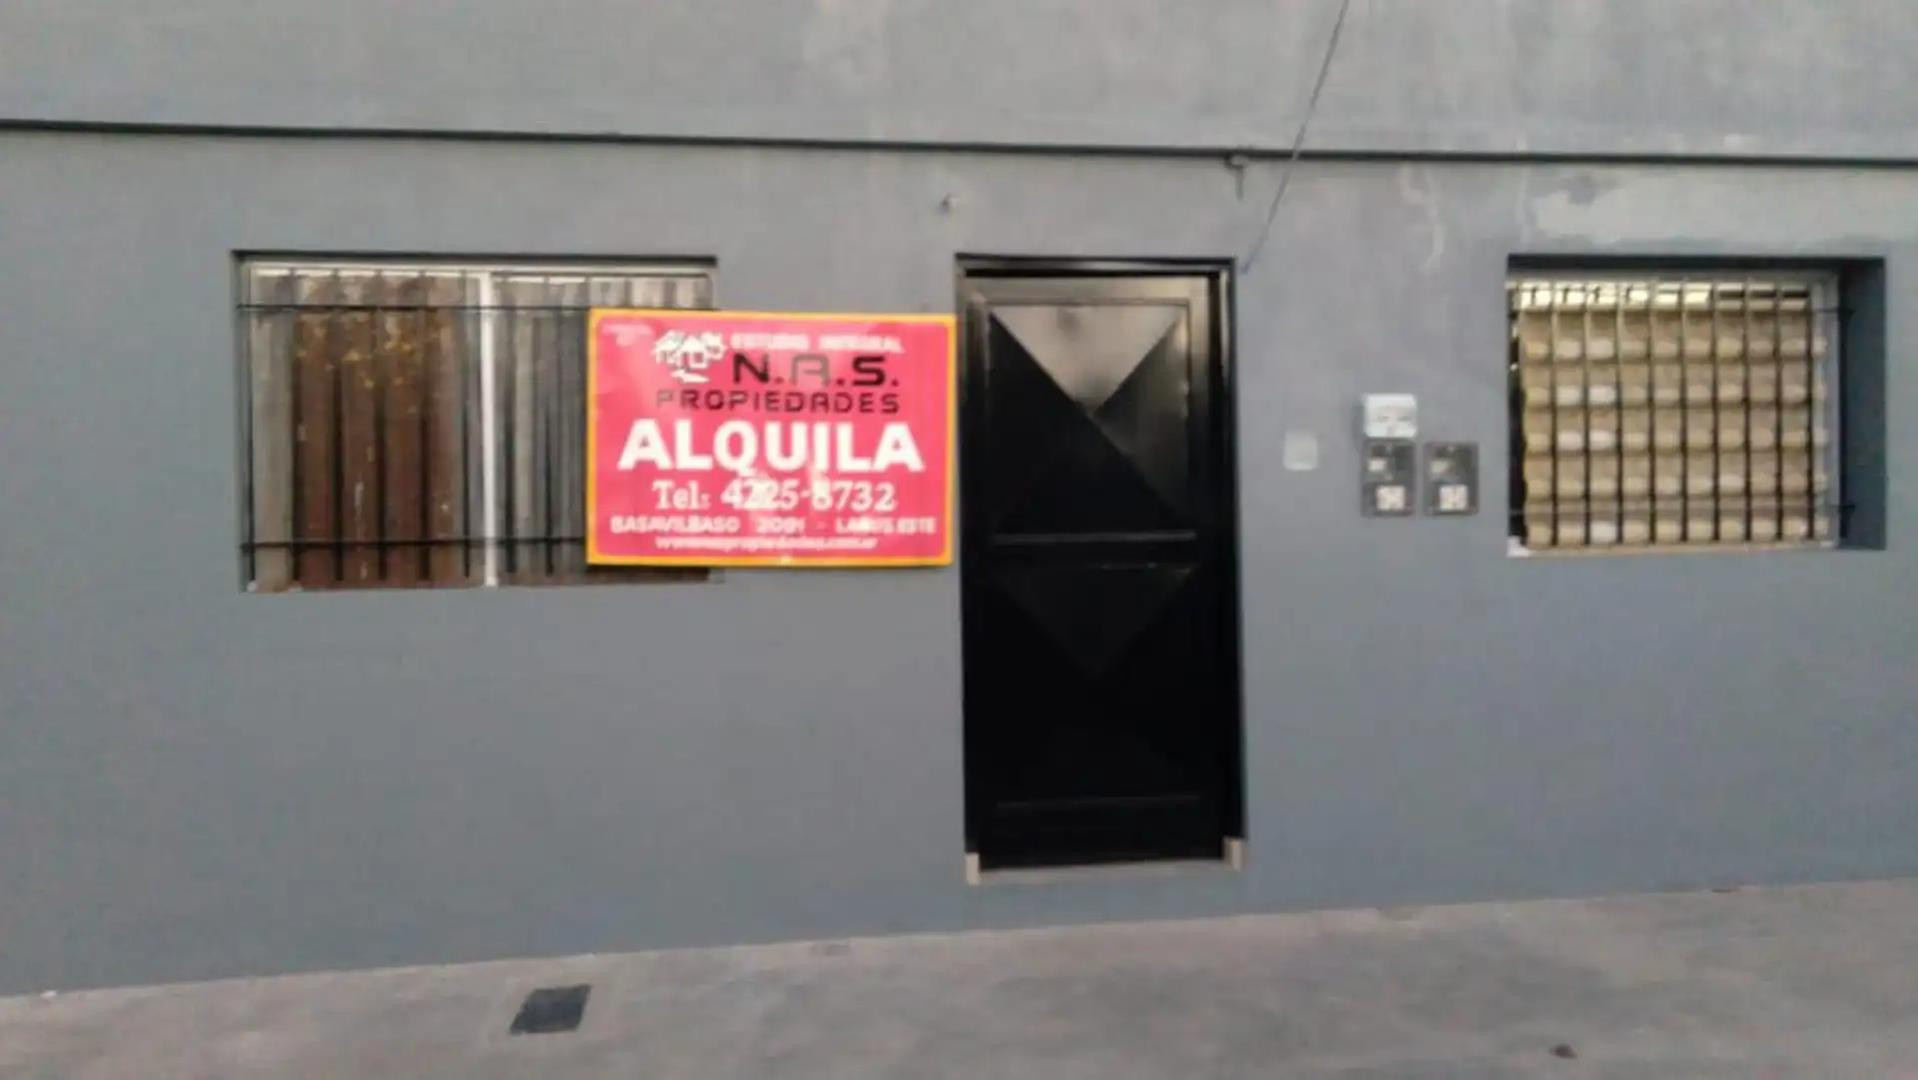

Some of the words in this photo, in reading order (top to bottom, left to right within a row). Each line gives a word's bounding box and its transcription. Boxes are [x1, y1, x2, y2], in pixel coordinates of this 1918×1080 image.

[733, 354, 899, 387] N.A.S.
[657, 390, 900, 414] PROPIEDADES
[617, 418, 925, 476] ALQUILA
[652, 480, 710, 510] Tel:
[720, 479, 898, 511] 4225-8732
